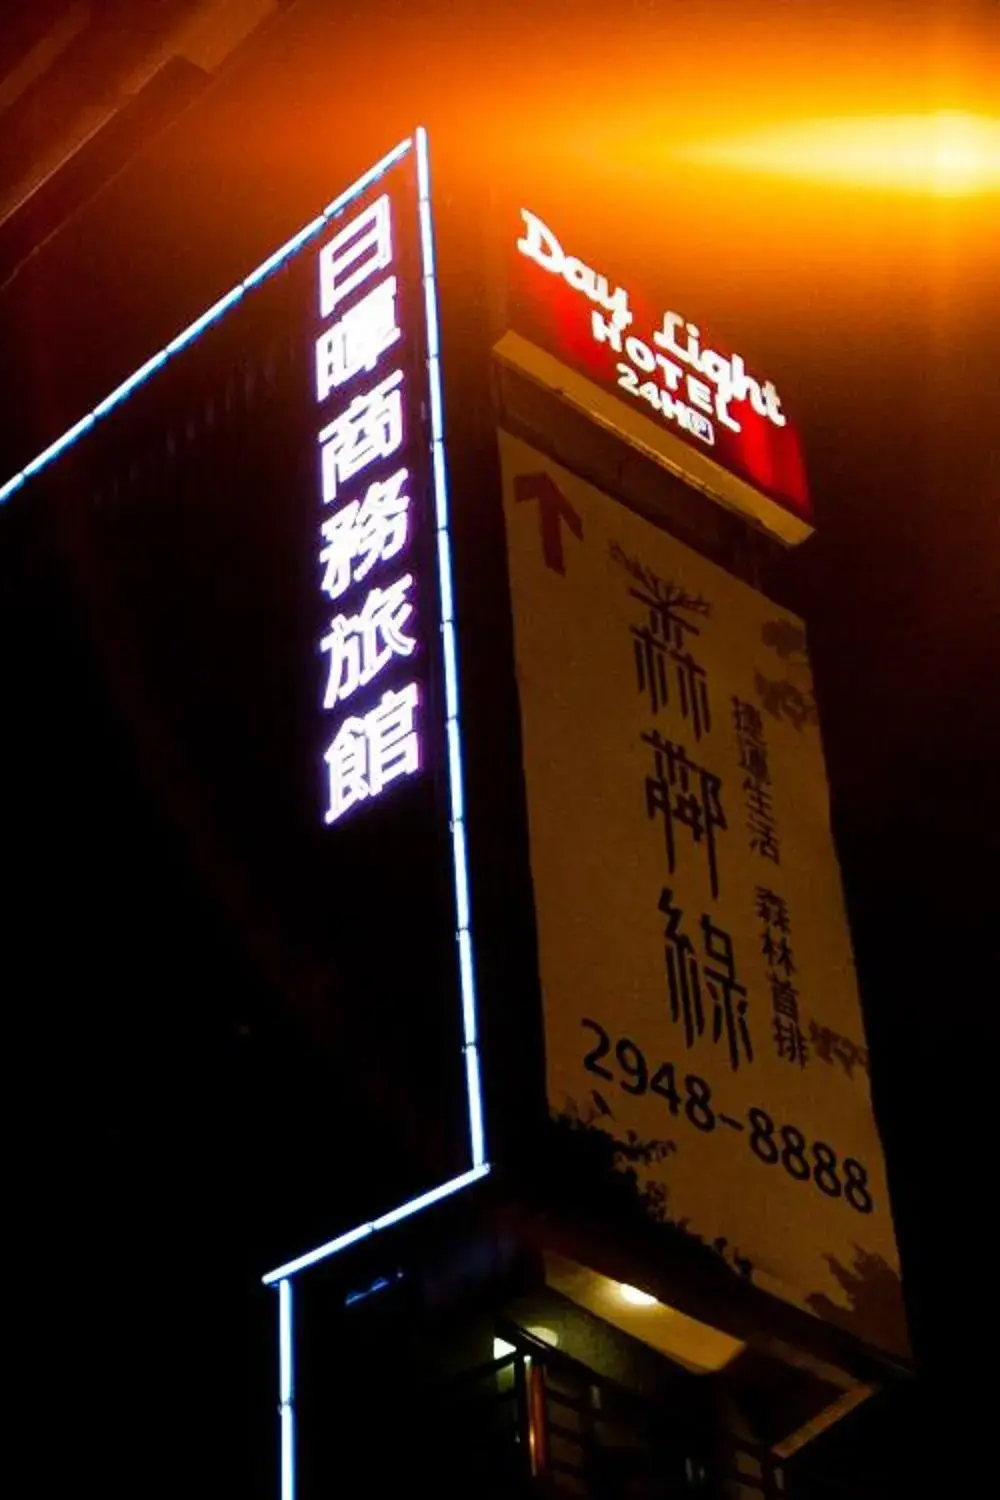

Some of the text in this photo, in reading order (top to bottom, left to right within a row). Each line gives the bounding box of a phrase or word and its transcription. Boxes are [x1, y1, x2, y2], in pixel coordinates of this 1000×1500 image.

[517, 207, 787, 428] Day Light
[592, 310, 741, 432] HOTEL
[316, 194, 423, 826] 日暉商務旅館
[580, 1017, 872, 1214] 2948-8888
